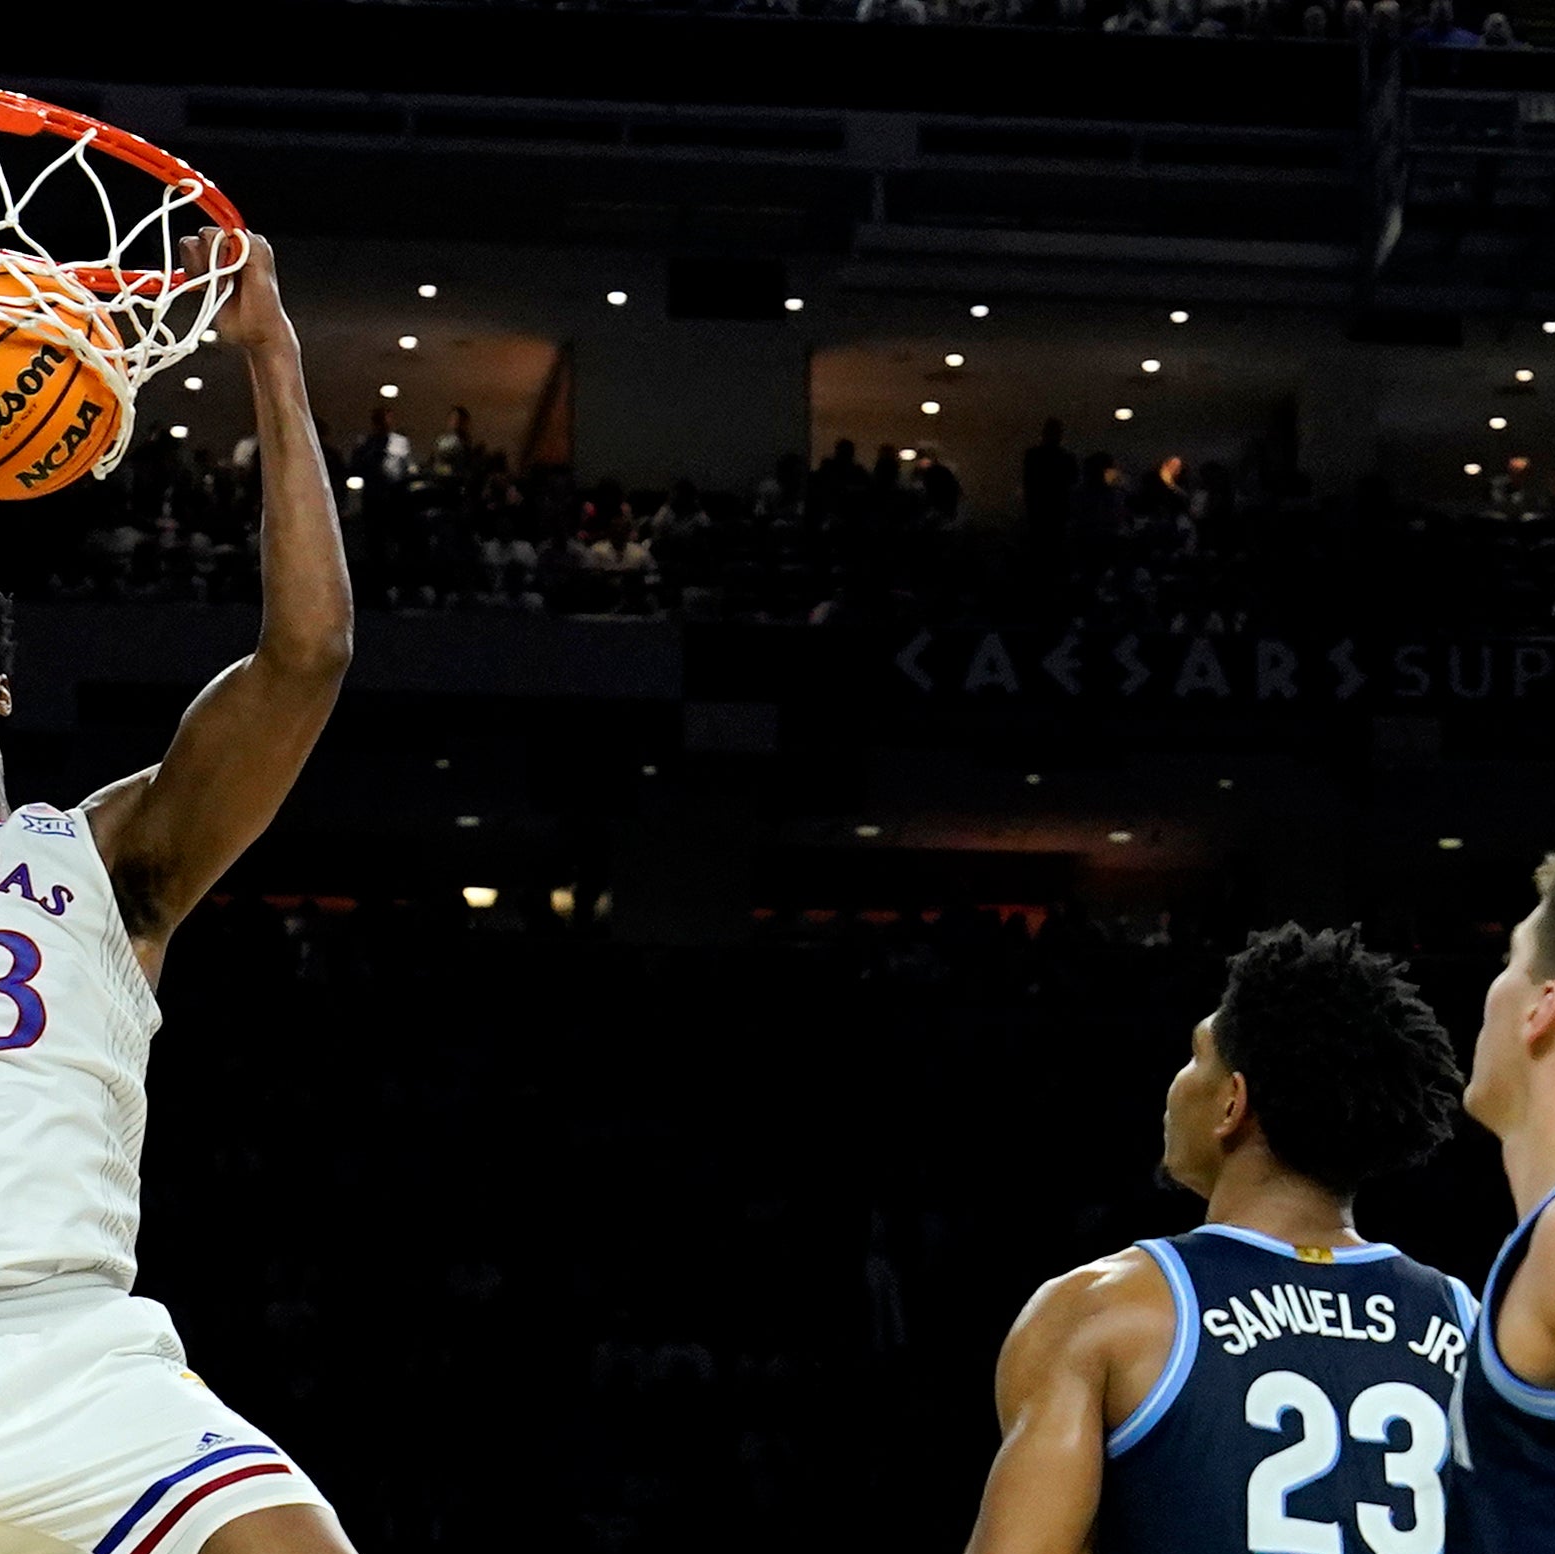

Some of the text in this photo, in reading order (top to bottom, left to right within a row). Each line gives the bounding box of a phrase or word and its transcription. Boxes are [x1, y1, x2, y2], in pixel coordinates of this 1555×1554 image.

[16, 400, 104, 488] NCAA
[893, 627, 1368, 698] CAESARS
[1203, 1284, 1396, 1356] SAMUELS
